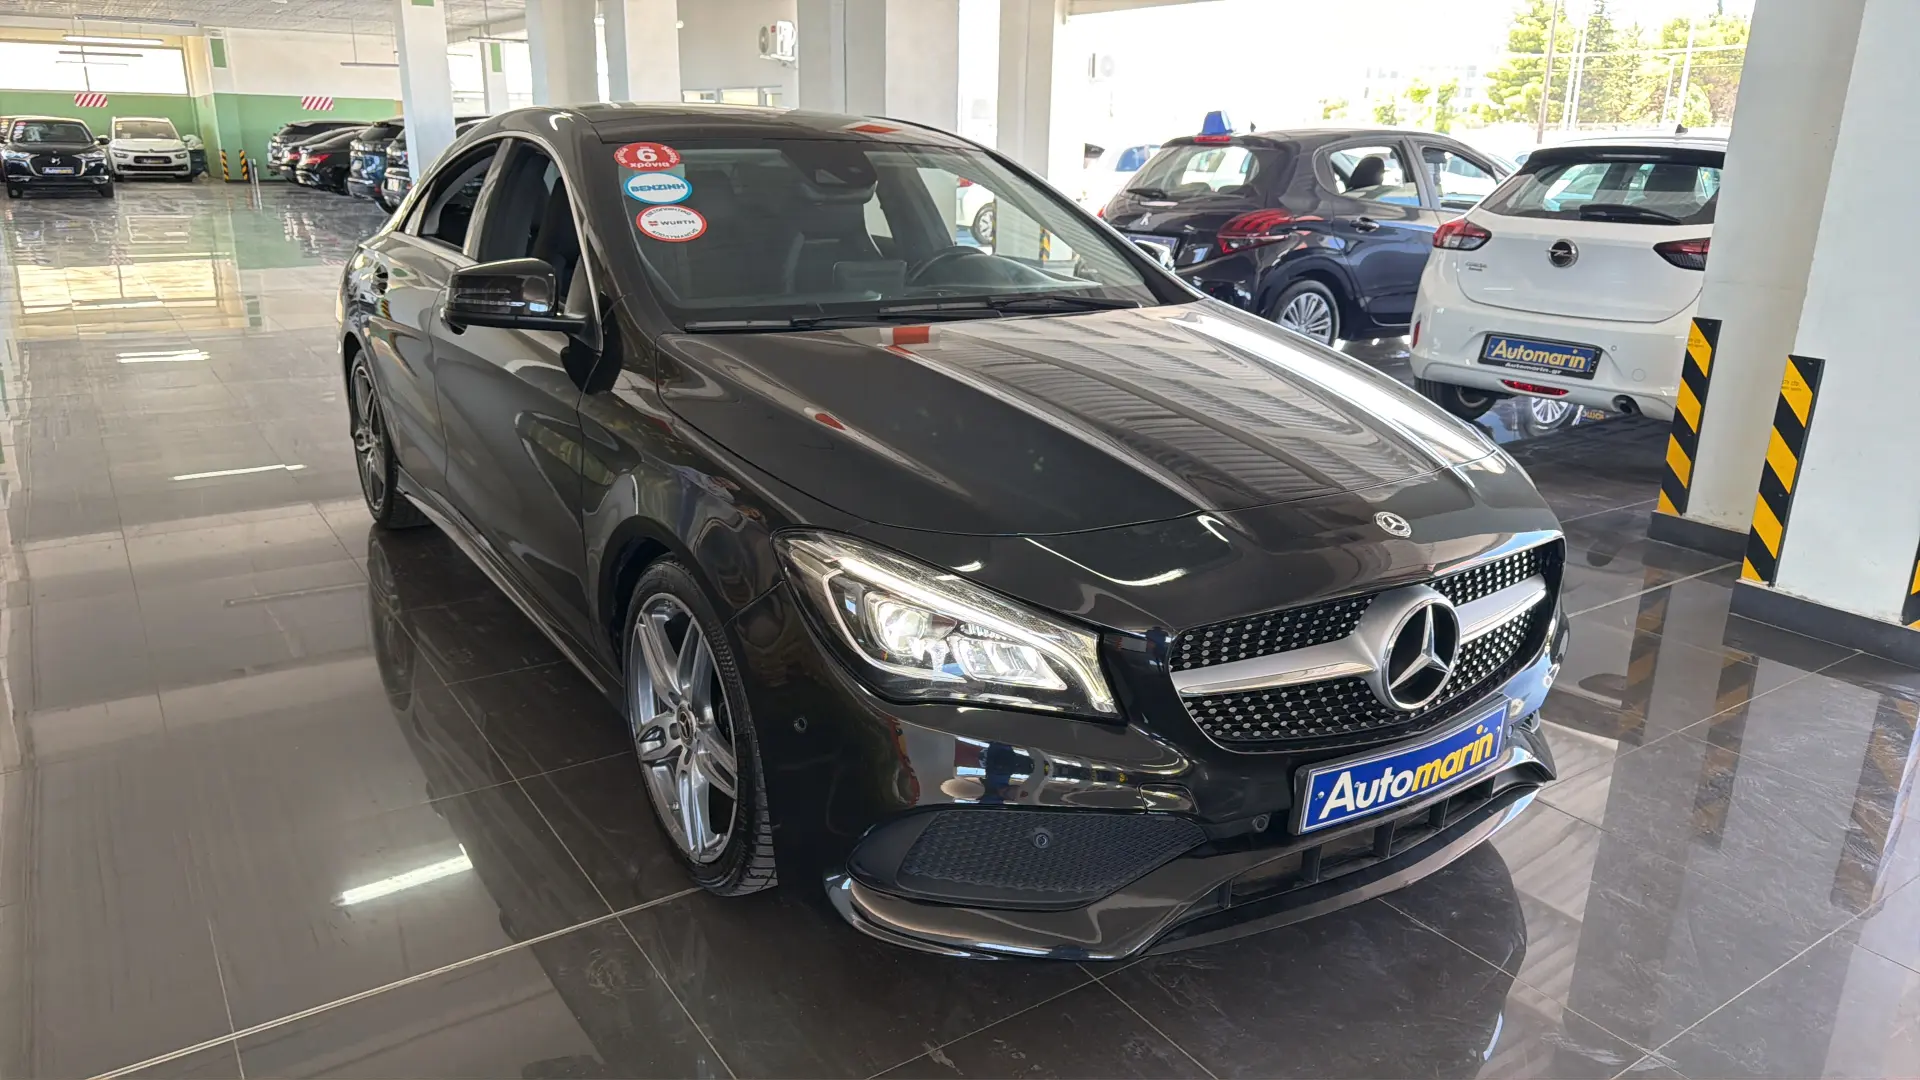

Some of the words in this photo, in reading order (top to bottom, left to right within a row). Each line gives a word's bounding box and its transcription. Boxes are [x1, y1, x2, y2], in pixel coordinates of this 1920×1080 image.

[636, 148, 658, 162] 6
[1490, 339, 1586, 369] Automarin
[1505, 362, 1562, 375] Automarin.gr
[1318, 724, 1494, 820] Automarin
